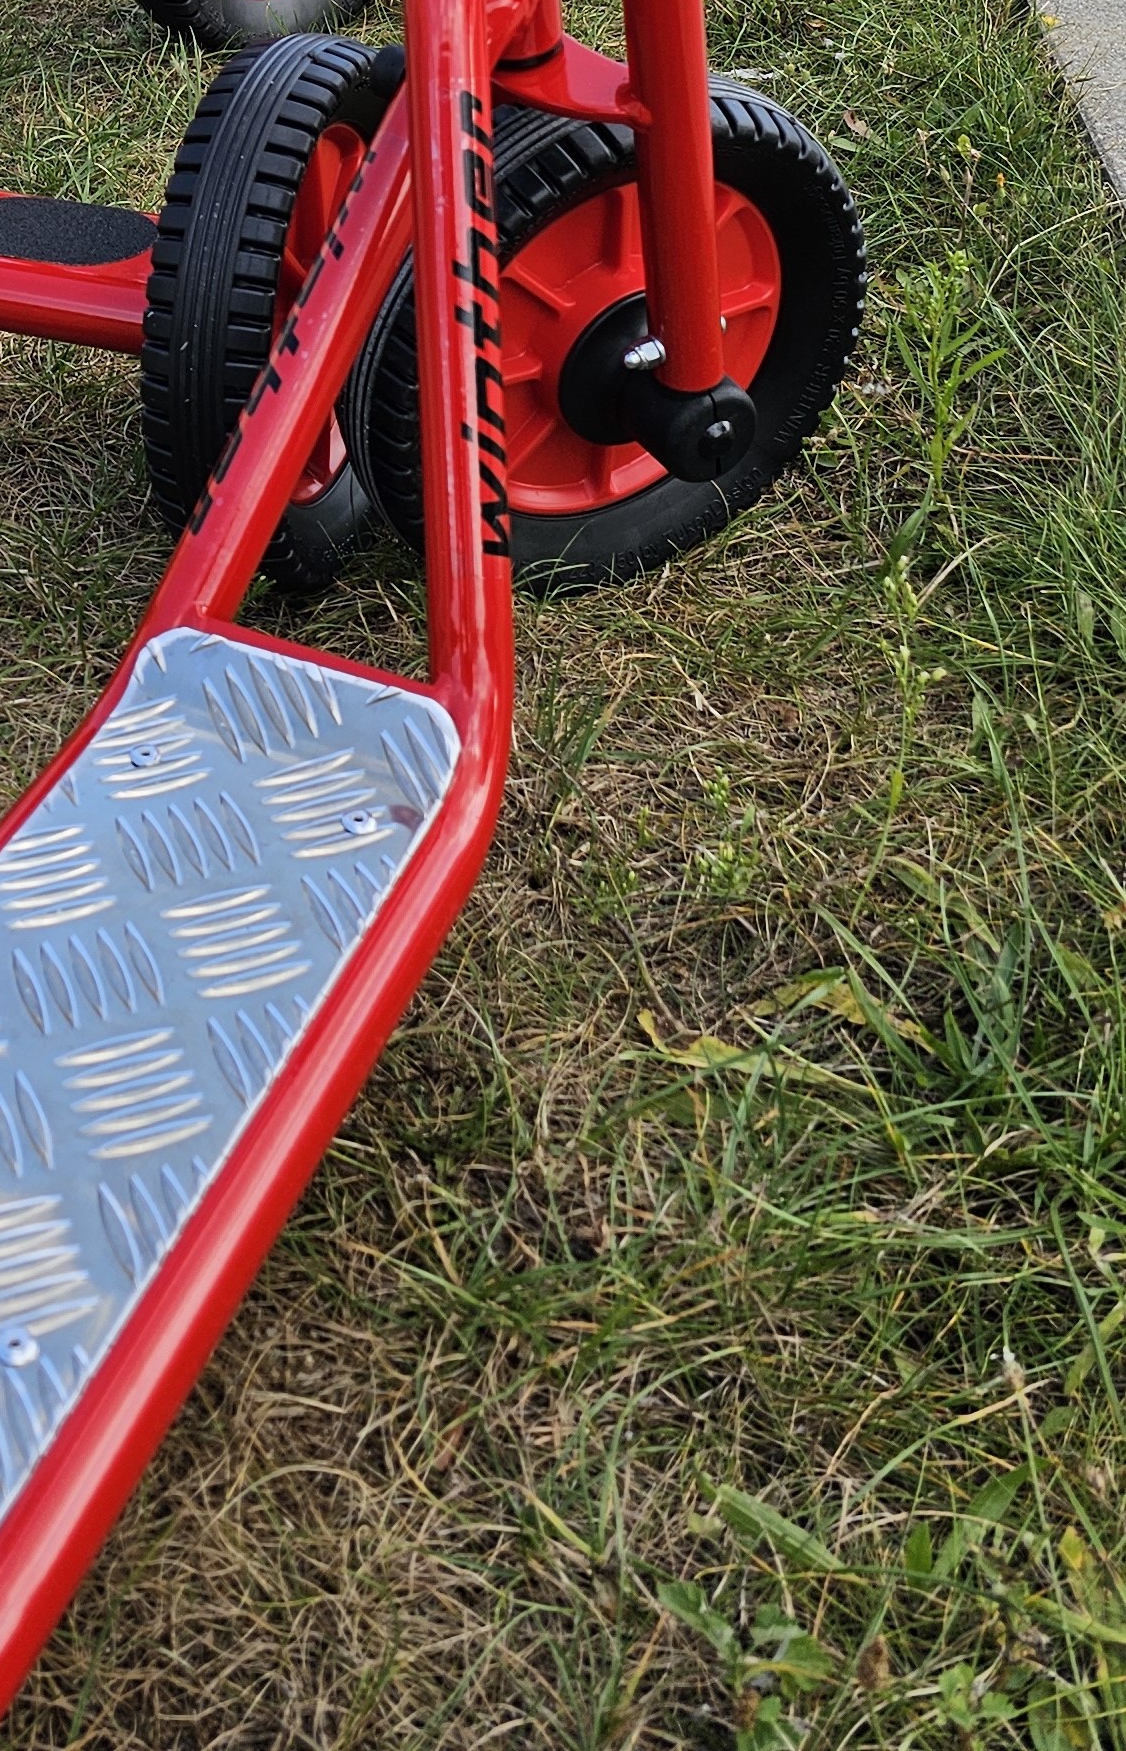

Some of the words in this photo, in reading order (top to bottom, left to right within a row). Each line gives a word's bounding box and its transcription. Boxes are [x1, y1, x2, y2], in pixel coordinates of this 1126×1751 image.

[773, 362, 832, 444] WINTHER
[615, 548, 636, 569] 50
[641, 541, 660, 559] by
